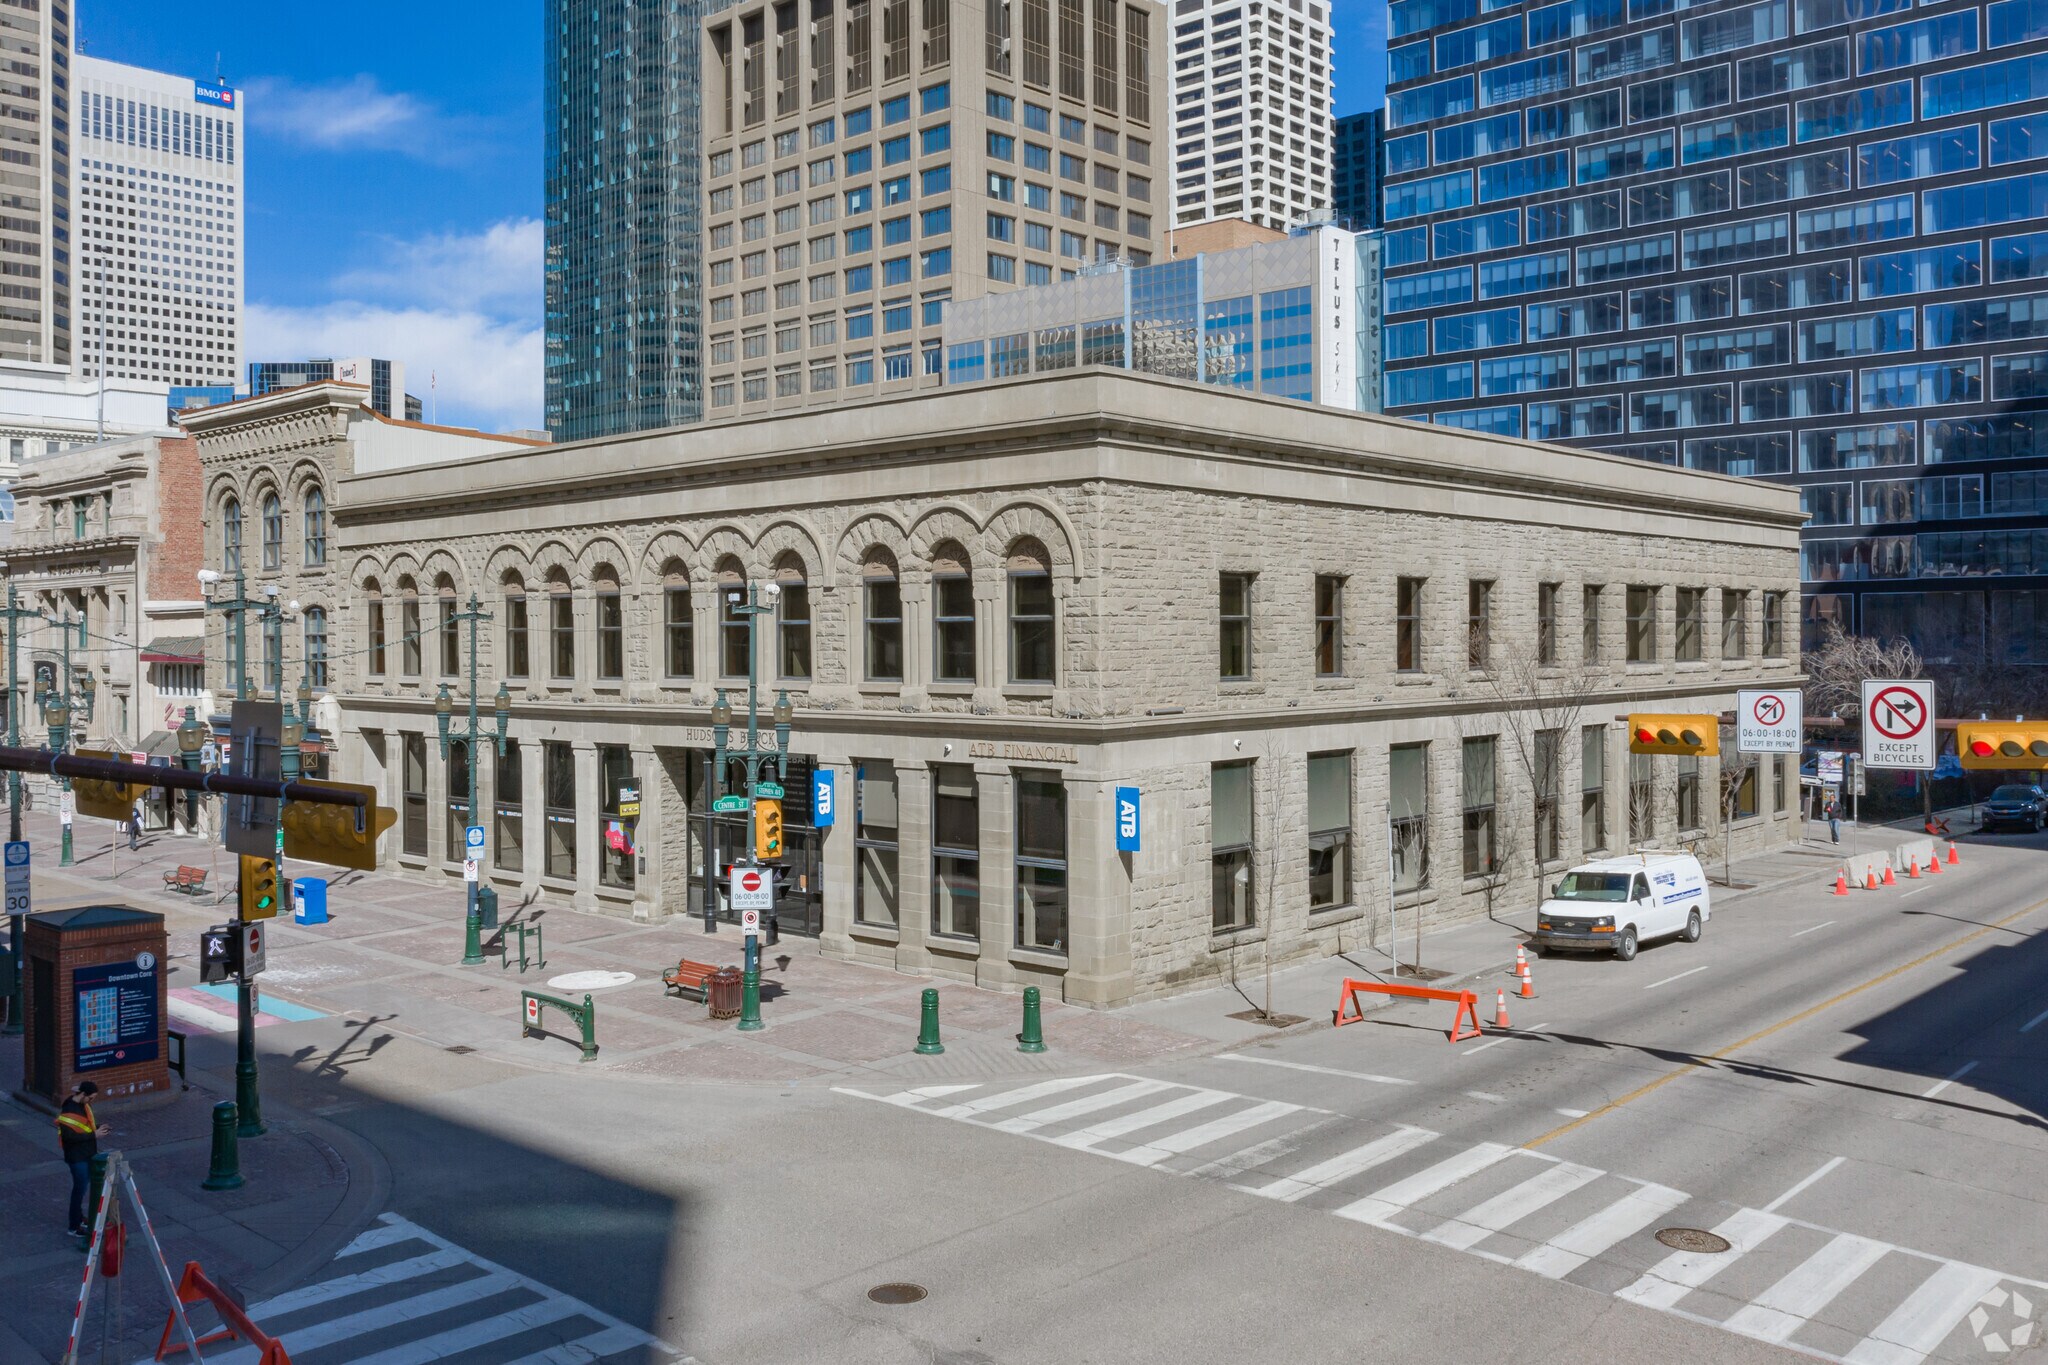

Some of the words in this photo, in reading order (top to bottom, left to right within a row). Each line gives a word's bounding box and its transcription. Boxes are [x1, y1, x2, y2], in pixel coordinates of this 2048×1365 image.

[197, 87, 220, 99] BMO
[686, 728, 734, 743] HUDSS
[740, 731, 775, 745] BCK
[1743, 729, 1796, 738] 06:00-18:00
[969, 743, 995, 758] ATB
[1004, 744, 1079, 764] FINANCIAL
[1879, 743, 1918, 752] EXCEPT
[1874, 753, 1924, 763] BICYCLES
[758, 787, 774, 795] STEPHEN
[818, 782, 831, 815] ATB
[1121, 800, 1136, 838] ATB
[7, 896, 29, 910] 30
[108, 972, 139, 982] Downtown
